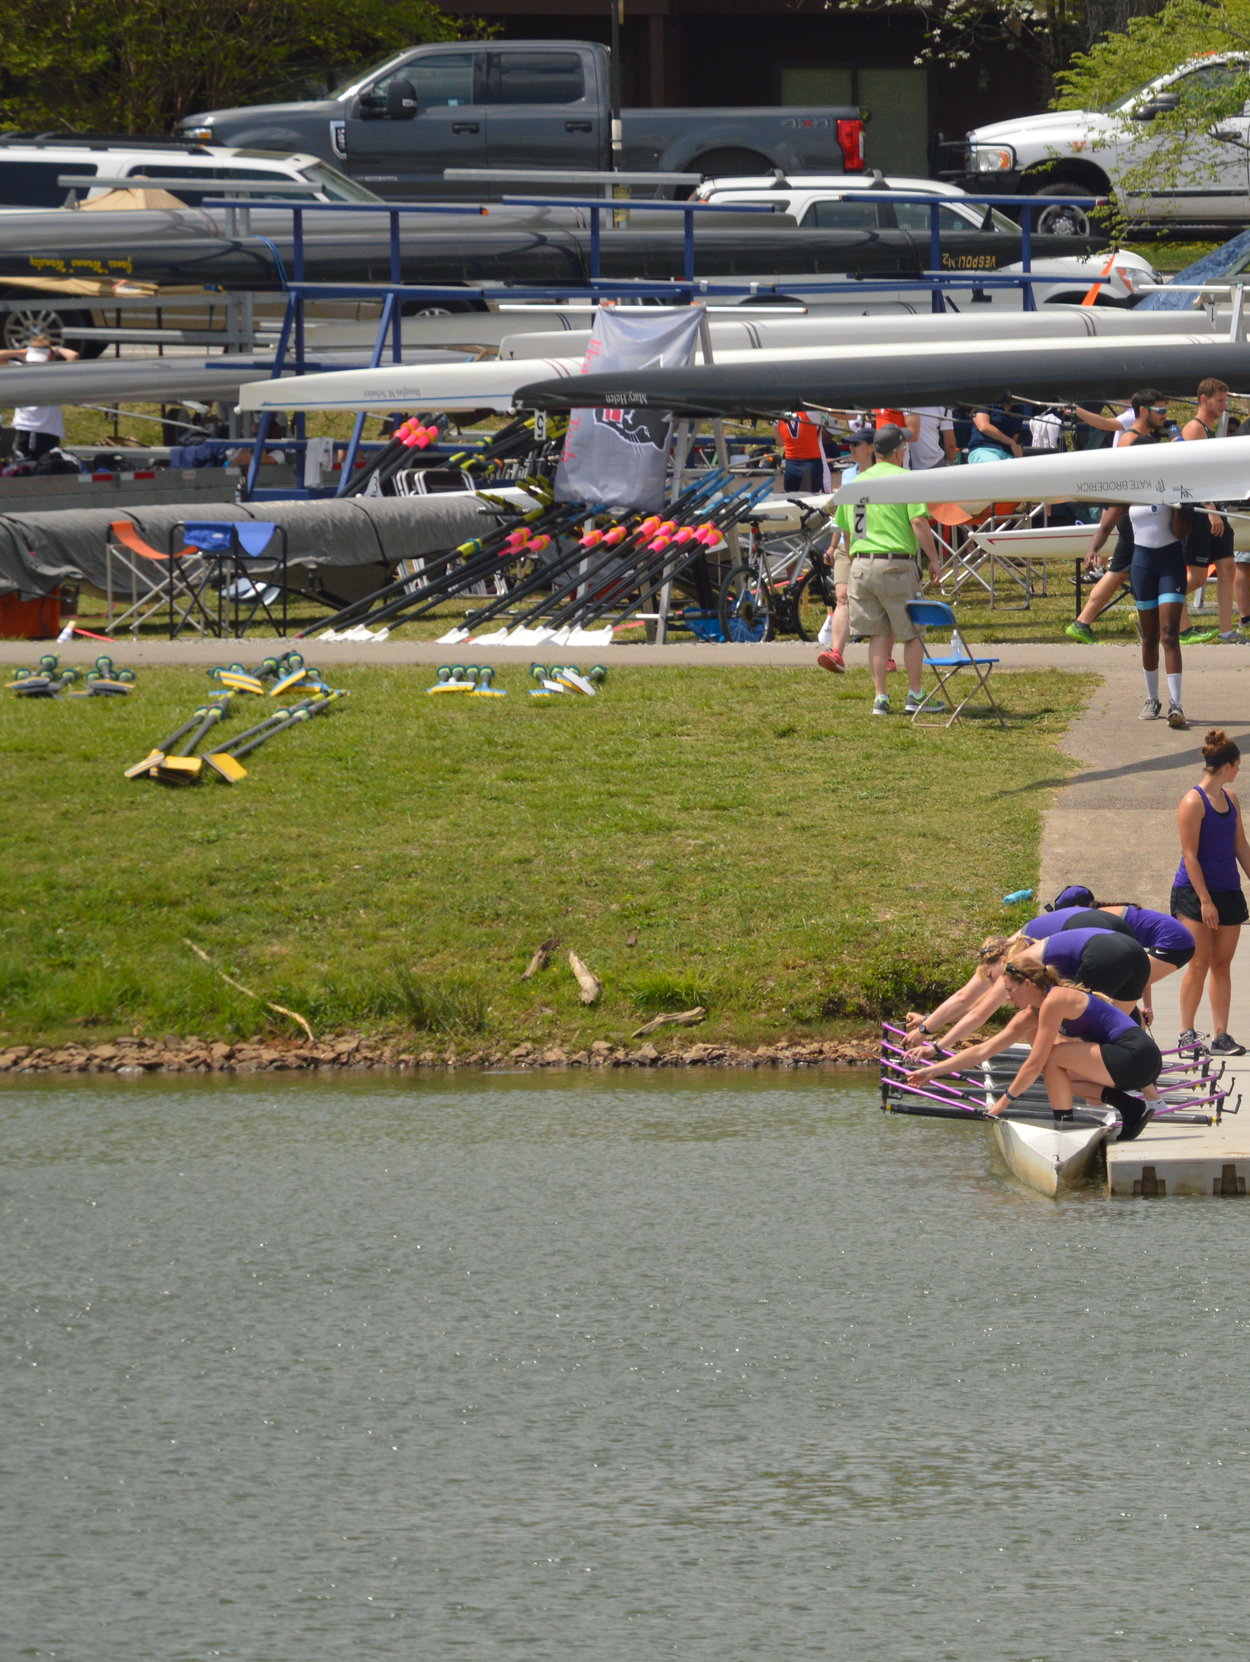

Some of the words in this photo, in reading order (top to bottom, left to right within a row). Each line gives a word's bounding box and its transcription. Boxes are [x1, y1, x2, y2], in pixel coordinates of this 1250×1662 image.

[958, 255, 996, 268] VESPOLI
[605, 393, 628, 405] Helen
[629, 390, 649, 405] Mary
[1076, 480, 1129, 493] BRODERICK
[1130, 479, 1153, 490] KATE
